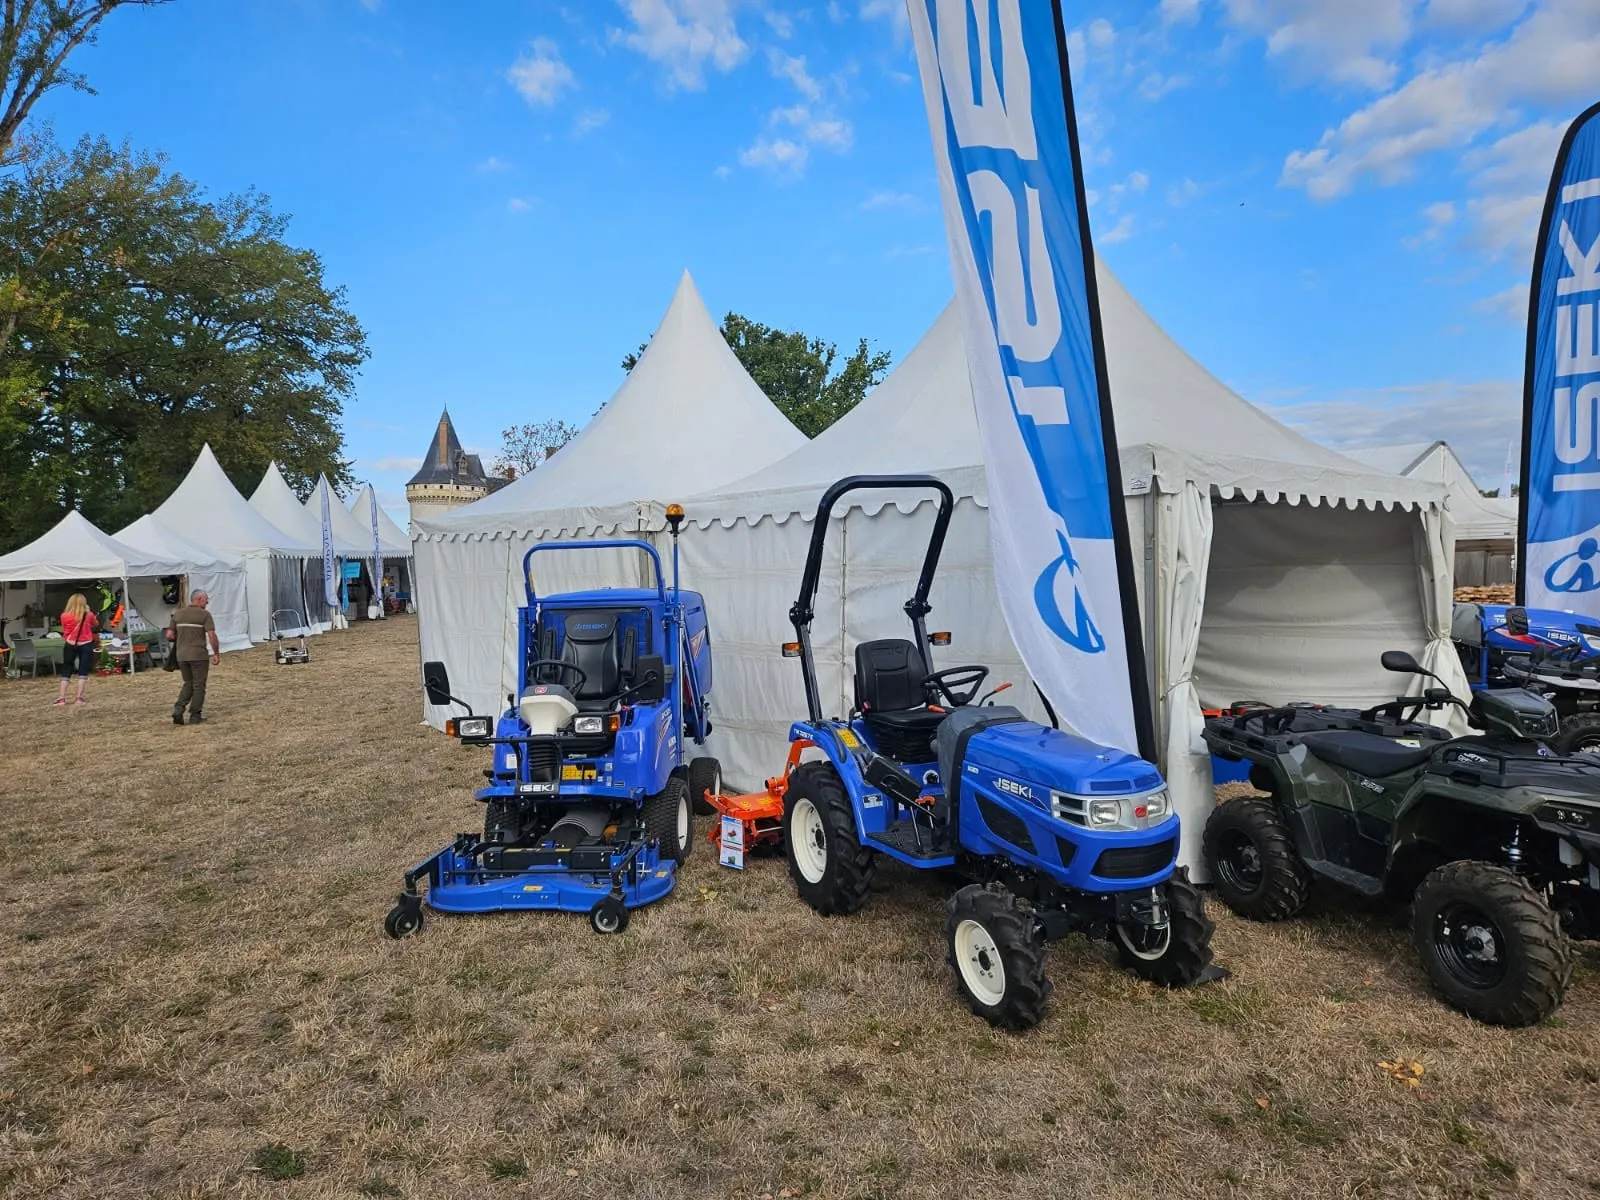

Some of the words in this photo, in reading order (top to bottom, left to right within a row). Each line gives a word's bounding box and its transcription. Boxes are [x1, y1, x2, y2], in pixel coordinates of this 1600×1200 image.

[1552, 176, 1600, 493] ISEKI
[1547, 631, 1580, 644] ISEKI
[520, 783, 554, 793] ISEKI
[997, 777, 1033, 799] ISEKI
